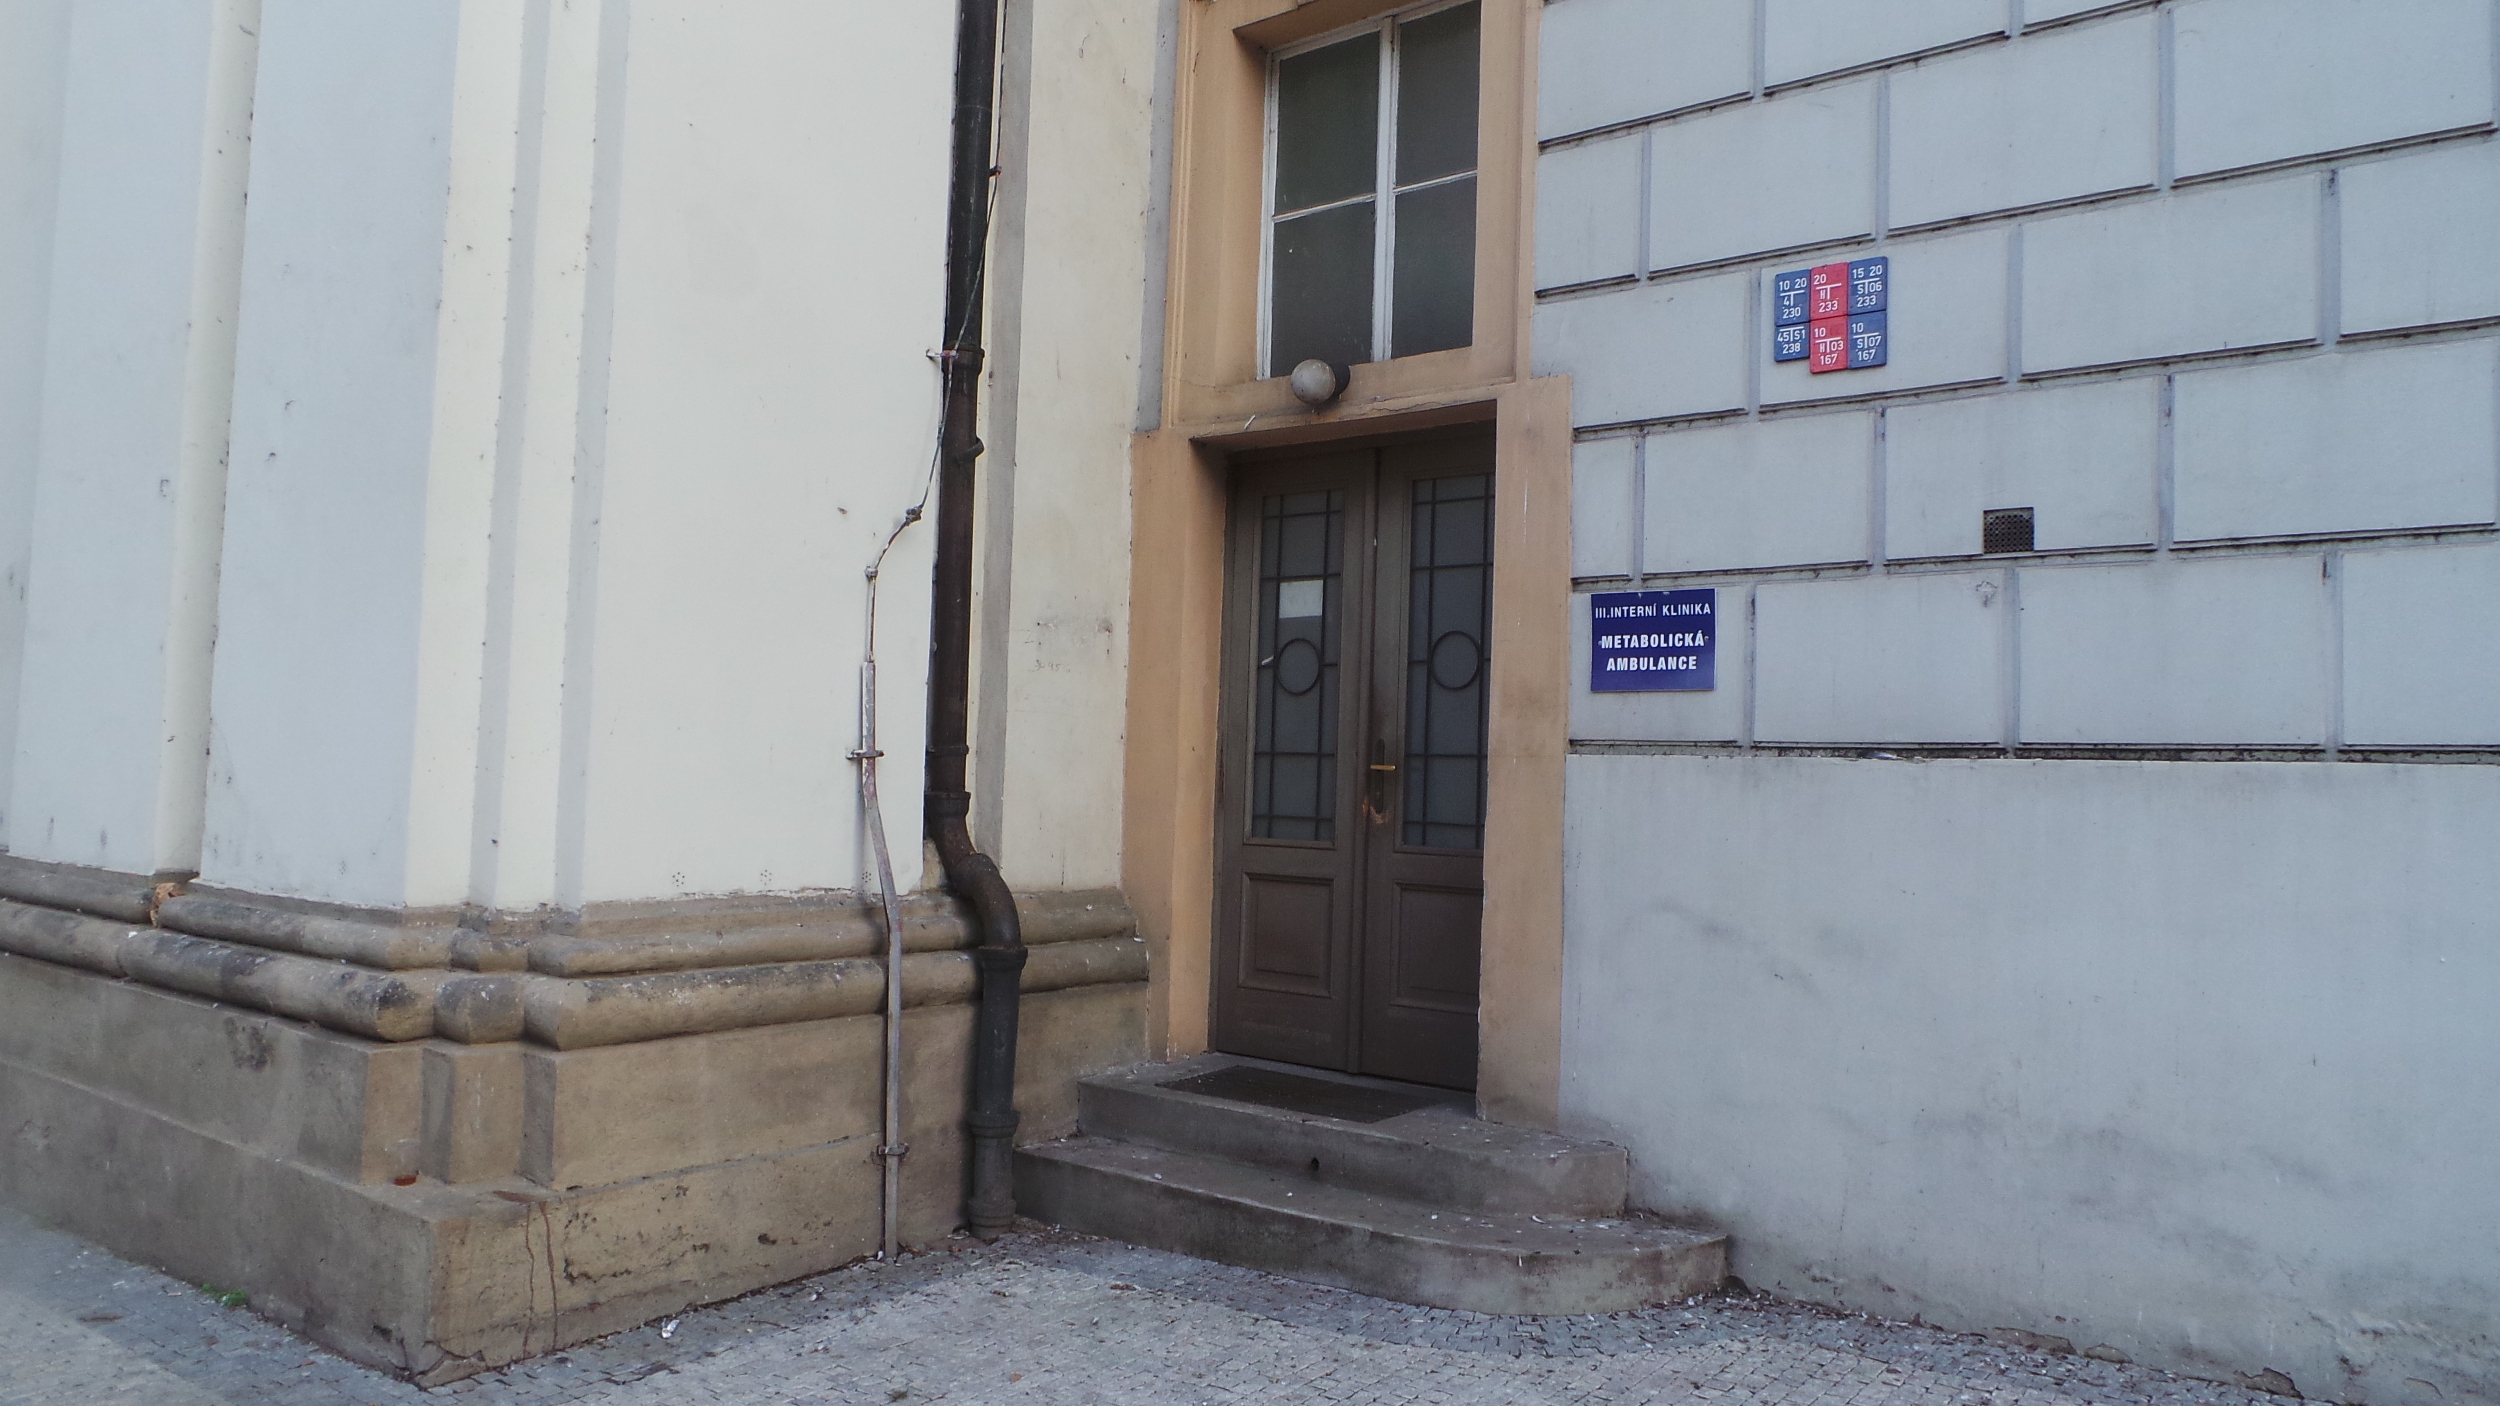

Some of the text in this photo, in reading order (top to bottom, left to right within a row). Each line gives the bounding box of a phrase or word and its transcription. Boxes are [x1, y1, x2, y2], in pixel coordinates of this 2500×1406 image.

[1852, 265, 1882, 278] 15 20
[1779, 278, 1807, 291] 10 20
[1814, 274, 1826, 285] 20
[1819, 301, 1838, 312] 233
[1857, 296, 1876, 307] 233
[1782, 307, 1801, 319] 230
[1814, 328, 1826, 338] 10
[1852, 323, 1864, 333] 10
[1782, 343, 1801, 354] 238
[1820, 354, 1838, 365] 167
[1858, 350, 1875, 361] 167
[1595, 603, 1711, 618] III.INTERNÍ KLINIKA
[1601, 630, 1705, 649] METABOLICKÁ
[1606, 656, 1697, 671] AMBULANCE
